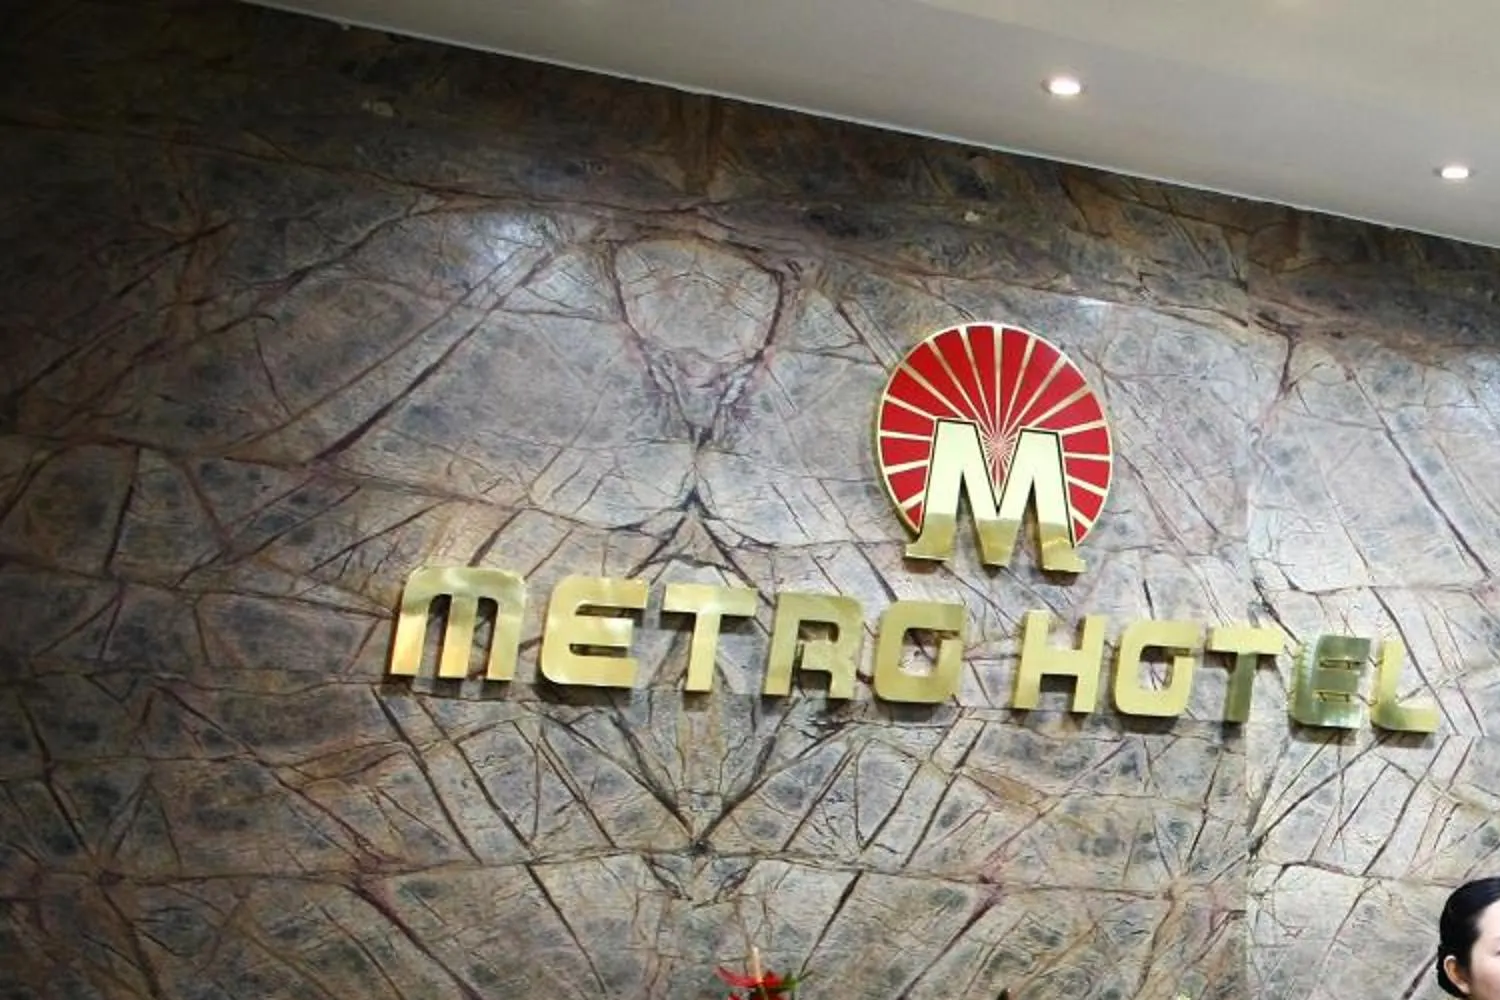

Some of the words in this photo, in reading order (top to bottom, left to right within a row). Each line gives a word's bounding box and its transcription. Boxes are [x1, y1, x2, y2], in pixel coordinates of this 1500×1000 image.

[904, 416, 1086, 574] M
[389, 565, 968, 703] METRO
[1009, 608, 1439, 733] HOTEL
